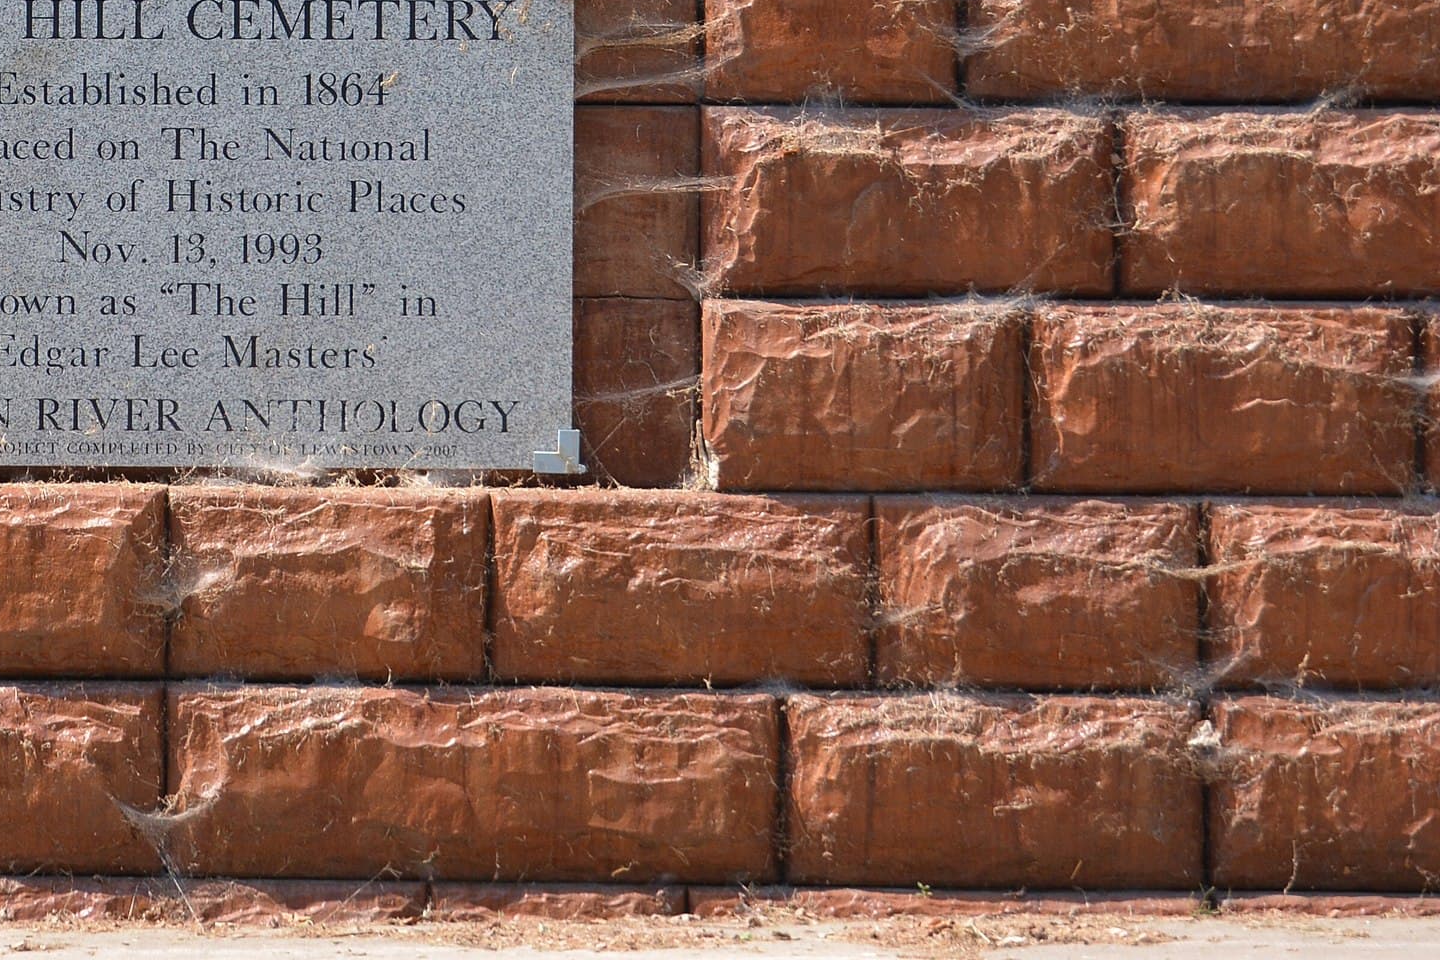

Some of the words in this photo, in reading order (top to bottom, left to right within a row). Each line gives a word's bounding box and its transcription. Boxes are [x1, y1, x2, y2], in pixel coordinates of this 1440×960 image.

[242, 73, 279, 106] in
[304, 73, 390, 107] 1864
[97, 138, 141, 161] on
[160, 127, 241, 161] The
[263, 128, 432, 162] National
[106, 178, 140, 213] of
[165, 179, 324, 214] Historic
[348, 180, 466, 214] Places
[59, 231, 148, 266] Nov.
[170, 232, 218, 269] 13,
[240, 232, 322, 265] 1993
[100, 296, 137, 317] as
[400, 285, 437, 316] in
[132, 334, 200, 369] Lee
[37, 398, 181, 433] RIVER
[206, 397, 520, 435] ANTHOLOGY
[66, 441, 178, 455] COMPLETED
[187, 441, 206, 456] BY
[216, 442, 258, 456] CITY
[301, 442, 418, 457] LEWISTOWN
[425, 442, 459, 458] 2007
